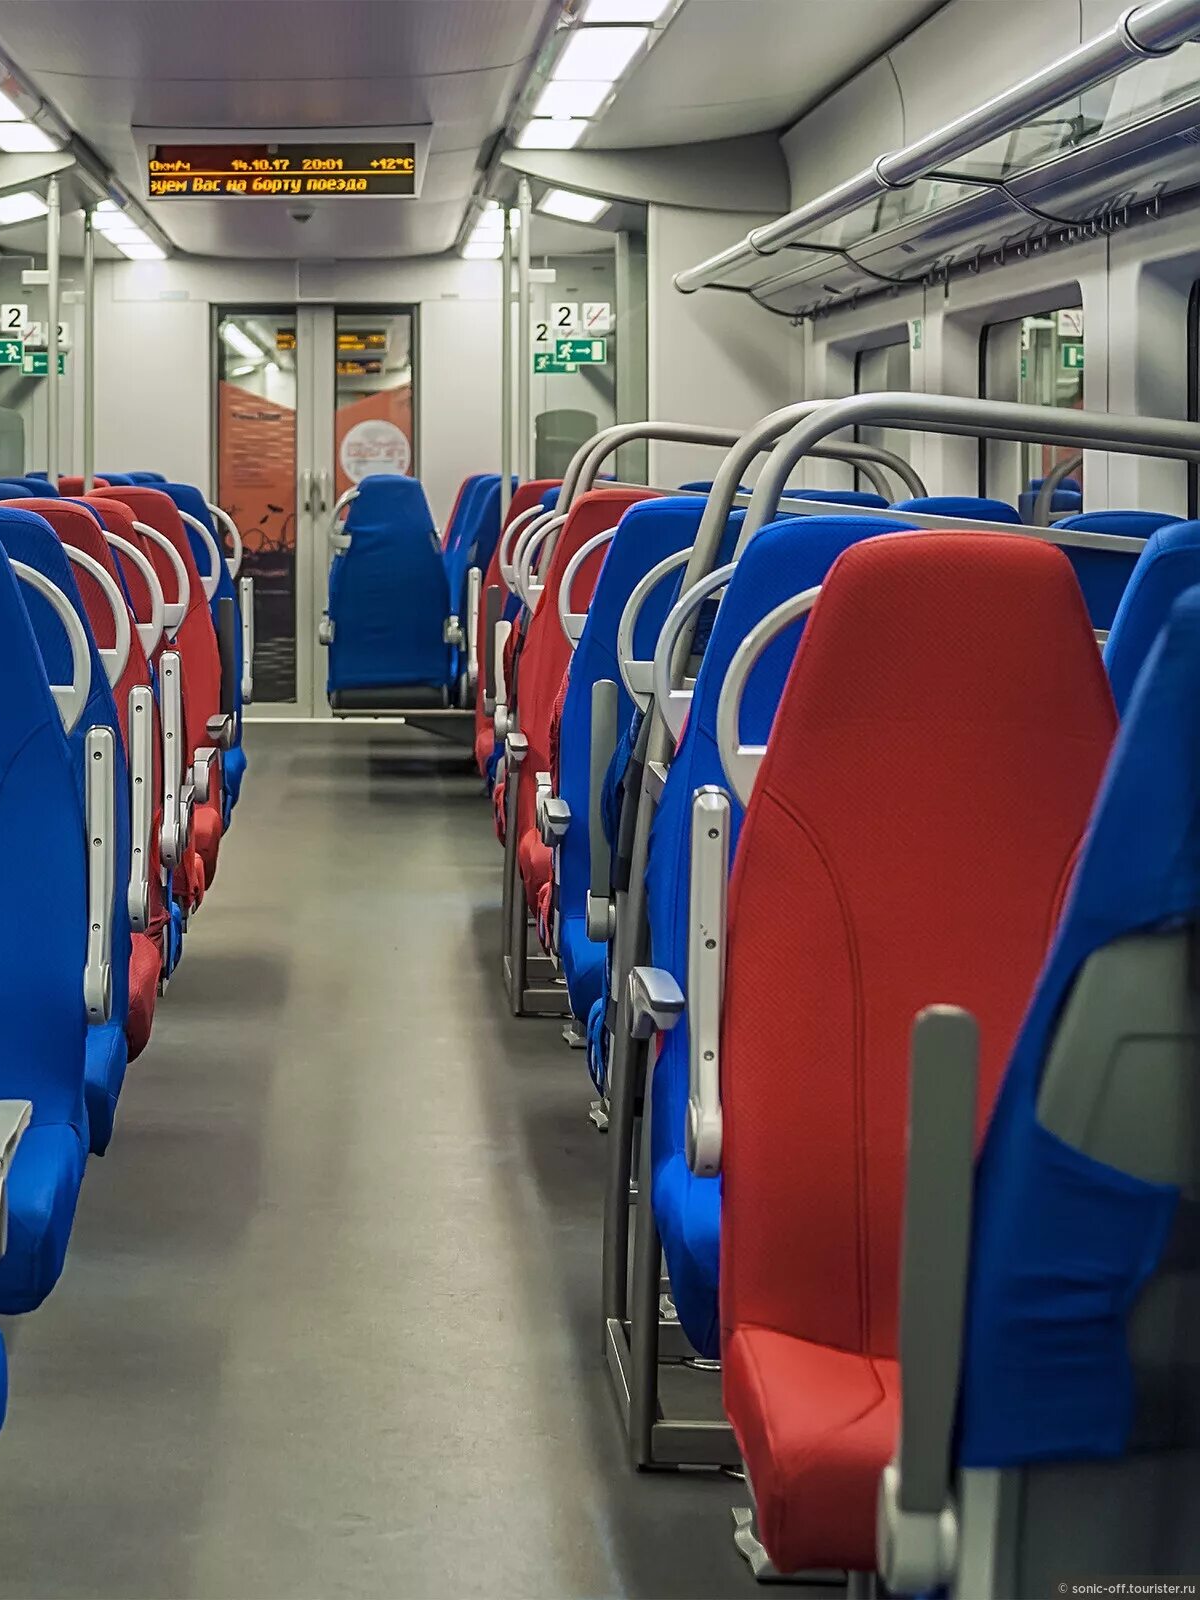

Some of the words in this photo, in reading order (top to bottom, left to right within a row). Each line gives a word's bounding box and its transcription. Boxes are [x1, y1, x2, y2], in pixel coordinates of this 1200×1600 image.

[231, 159, 290, 171] 14.10.17
[302, 159, 343, 170] 20:01
[191, 177, 221, 192] Вас
[226, 179, 247, 192] на
[252, 176, 302, 194] борту
[306, 178, 367, 192] поезда
[8, 308, 21, 328] 2
[558, 307, 571, 326] 2
[536, 323, 548, 341] 2
